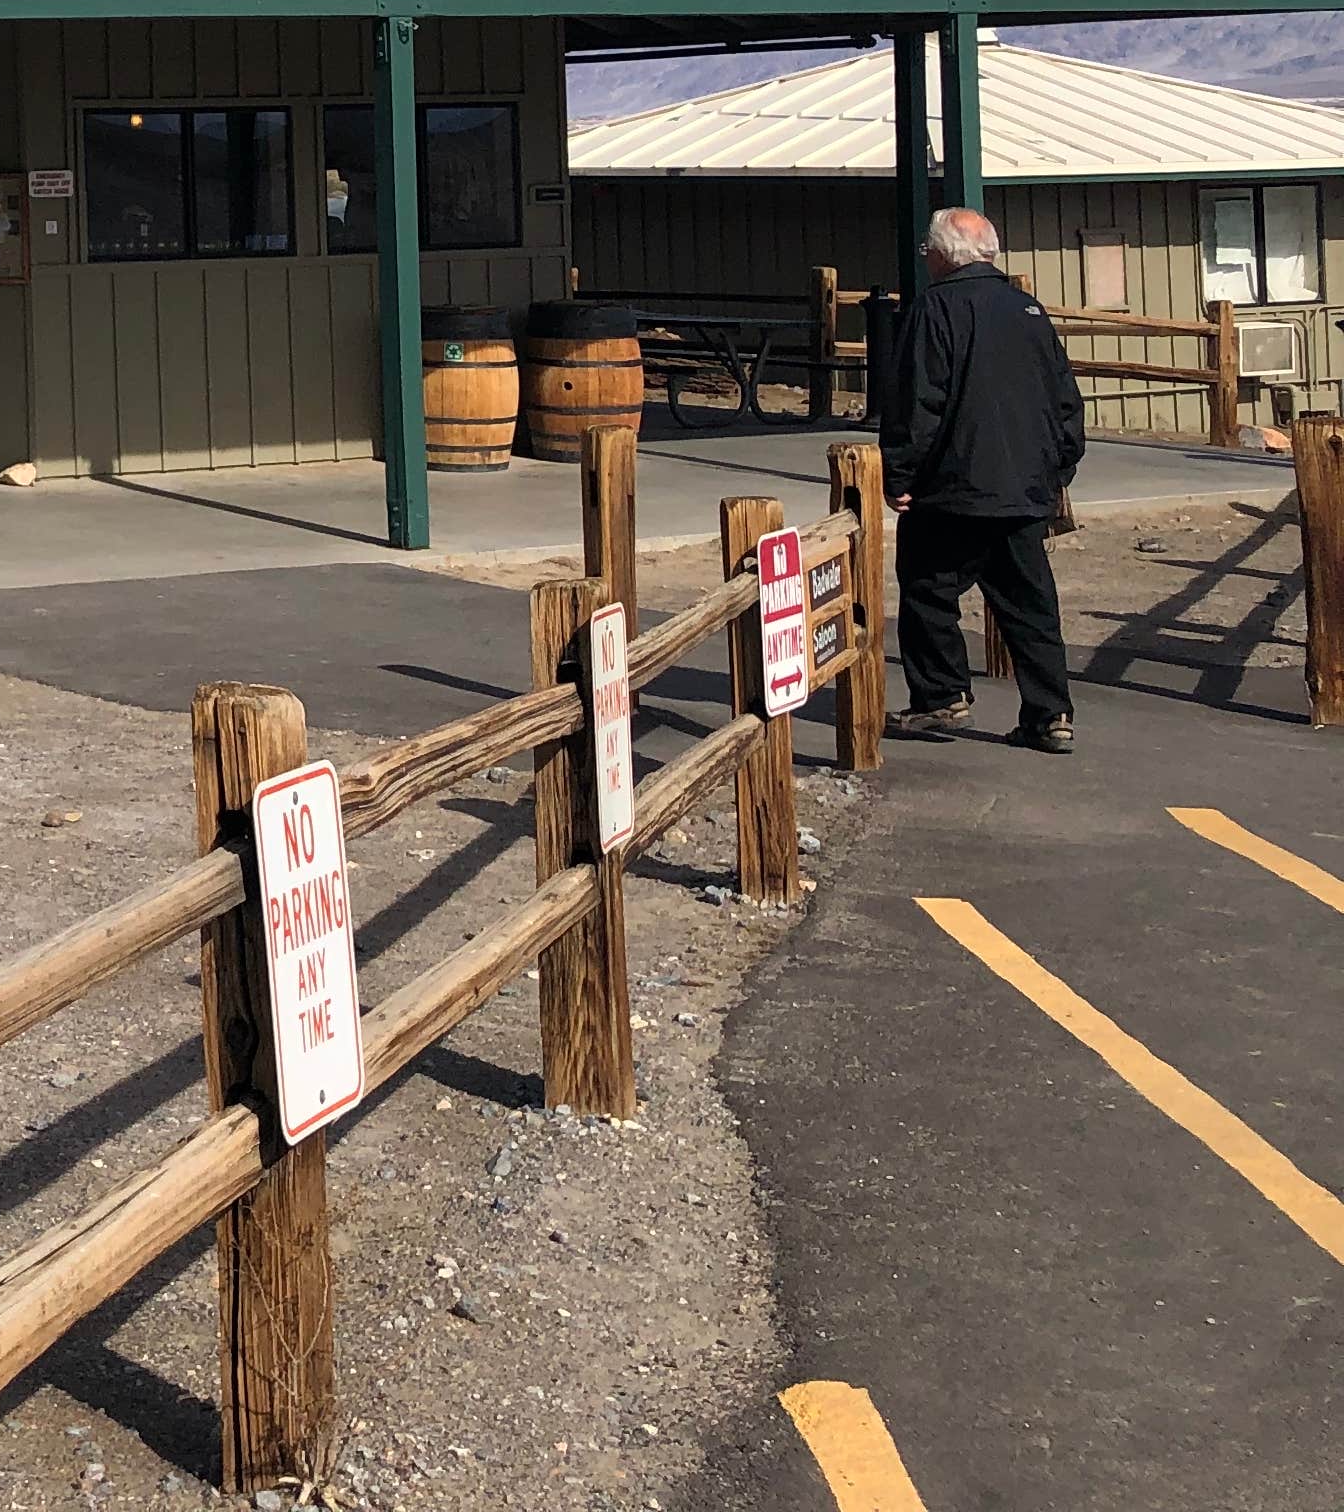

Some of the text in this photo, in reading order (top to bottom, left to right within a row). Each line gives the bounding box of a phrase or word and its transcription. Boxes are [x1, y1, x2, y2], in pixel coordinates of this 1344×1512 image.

[772, 543, 787, 577] NO
[812, 559, 842, 600] Badwater
[762, 574, 802, 615] PARKING
[601, 630, 616, 673] NO
[767, 625, 804, 665] ANYTIME
[813, 622, 838, 653] Saloon
[596, 676, 629, 729] PARKING
[606, 730, 619, 760] ANY
[283, 804, 315, 873] NO
[270, 870, 344, 959] PARKING
[298, 947, 327, 1001] ANY
[298, 998, 335, 1053] TIME
